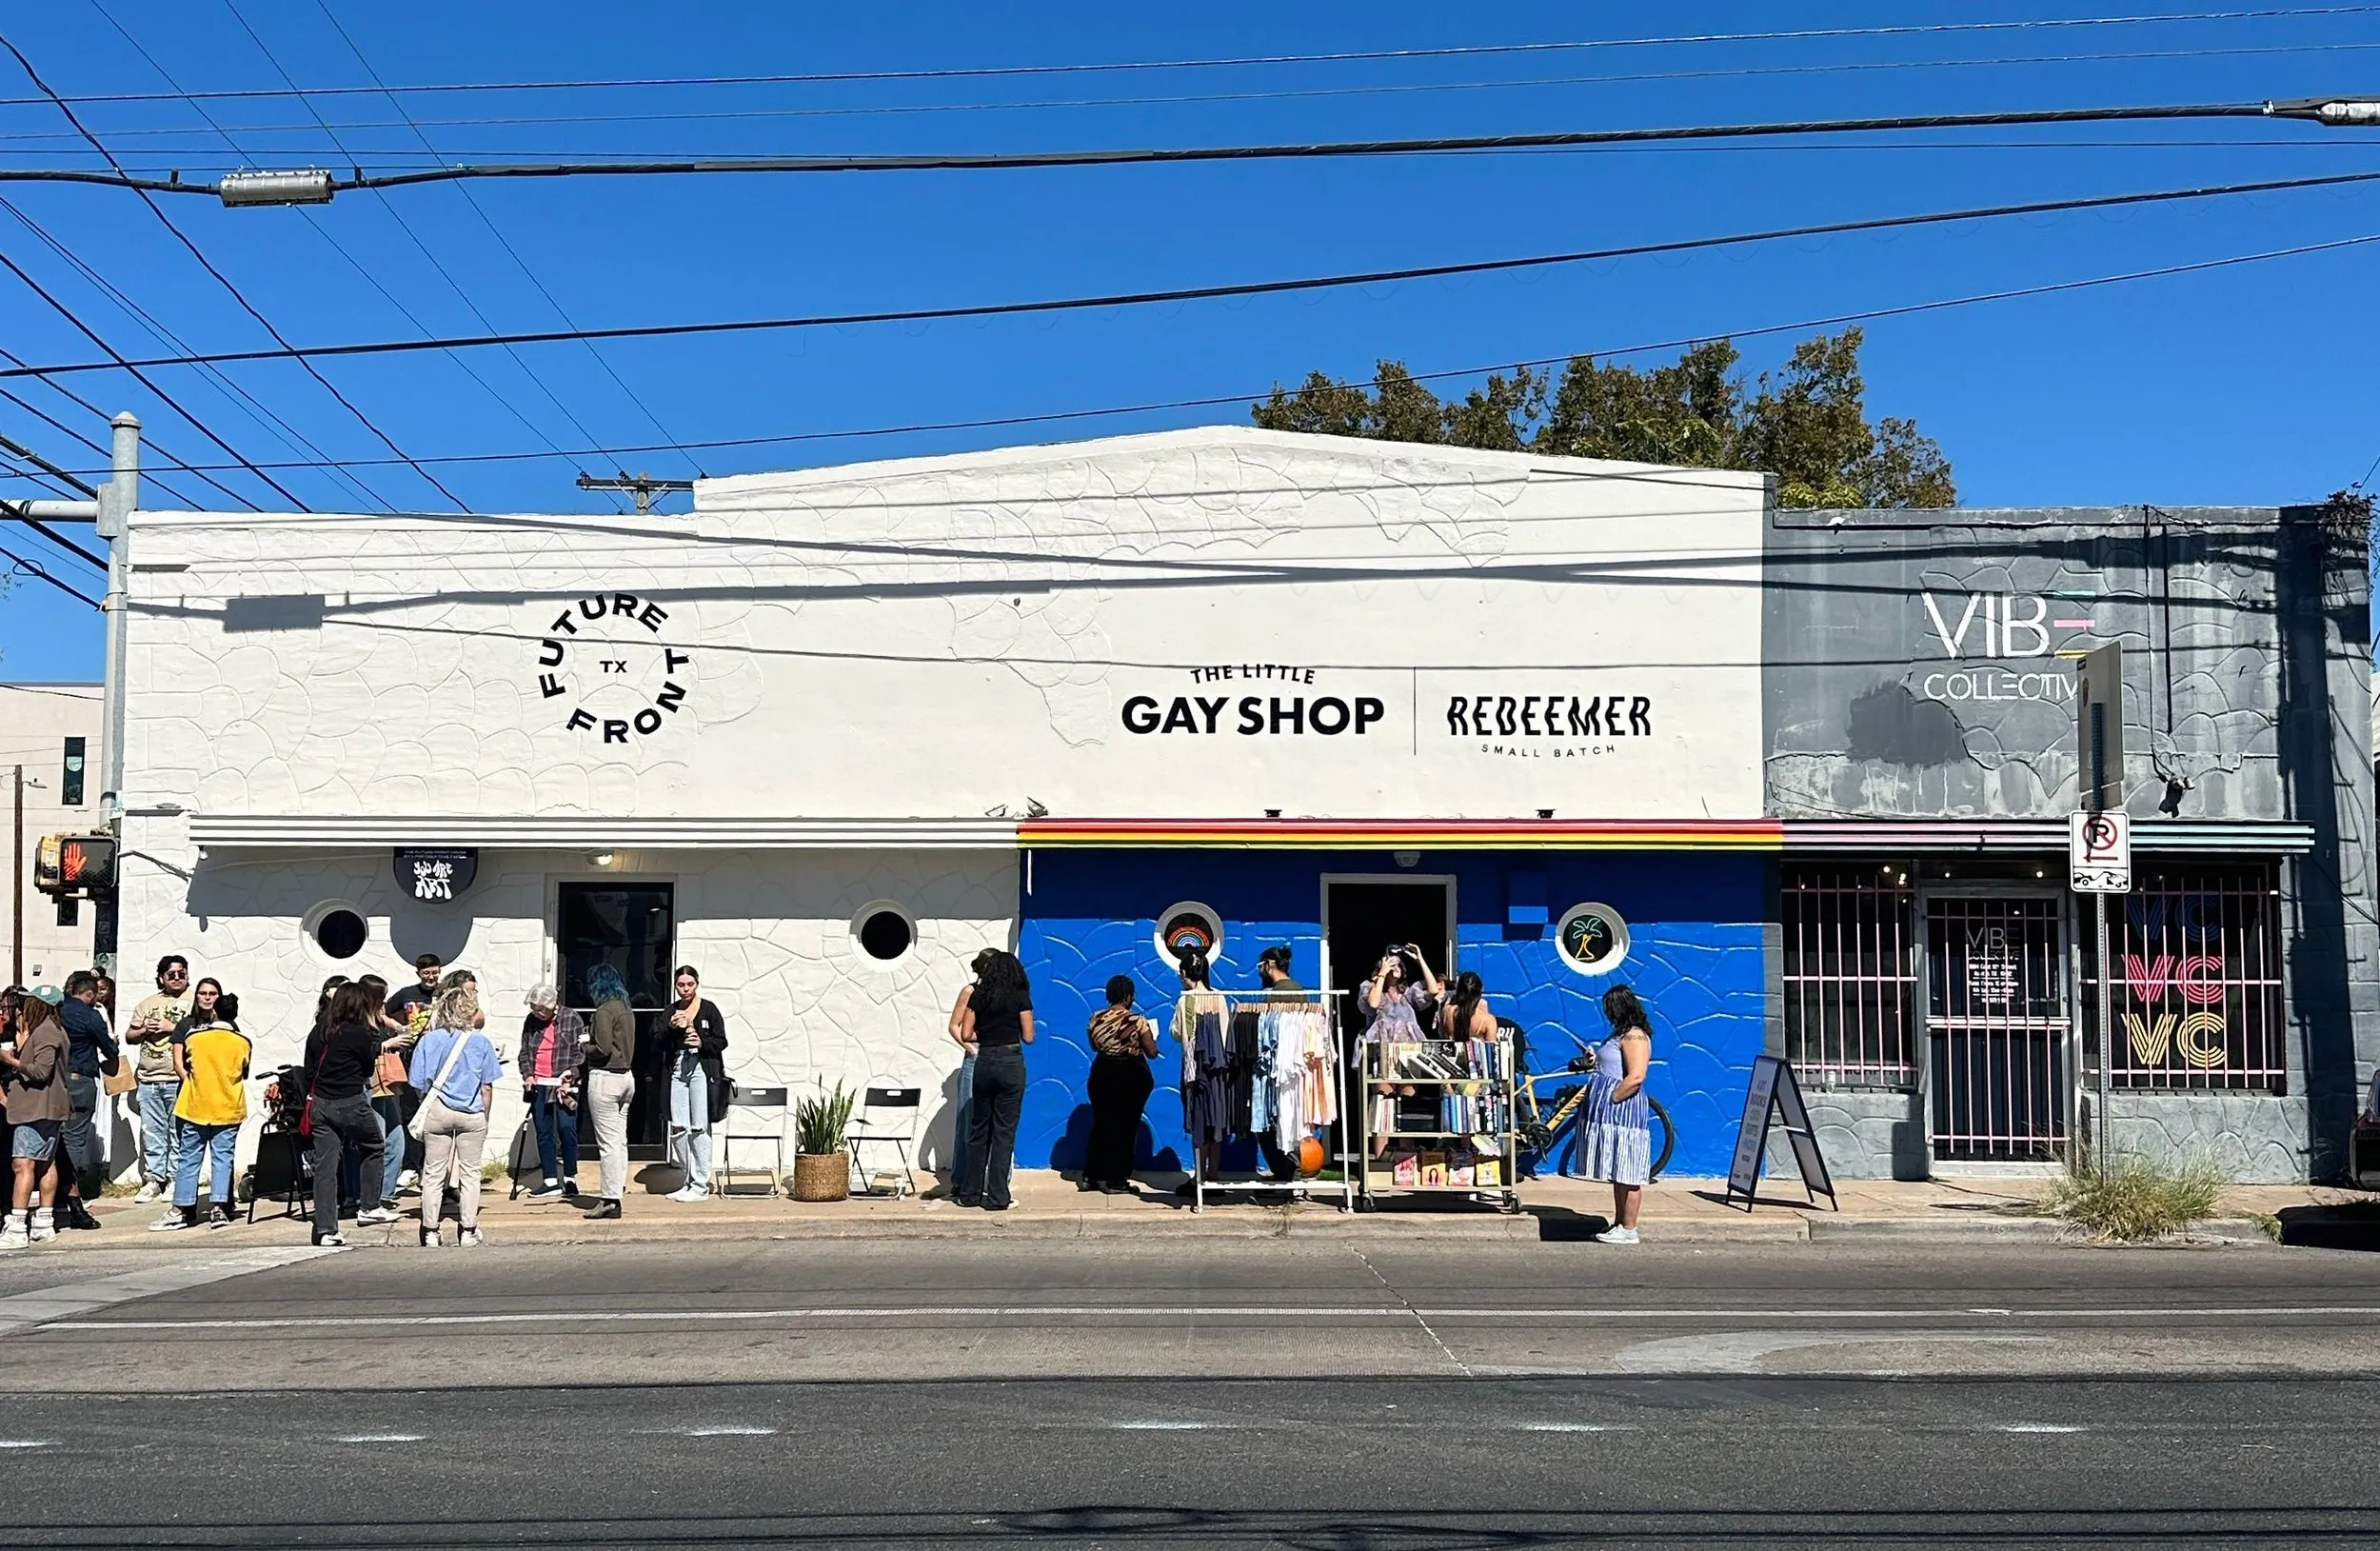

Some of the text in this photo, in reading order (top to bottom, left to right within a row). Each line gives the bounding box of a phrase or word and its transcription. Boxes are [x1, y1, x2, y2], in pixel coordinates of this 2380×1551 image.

[1921, 590, 2096, 659] VIBE
[538, 592, 669, 699] FUTURE
[599, 661, 628, 673] TX
[1190, 664, 1316, 685] THE LITTLE
[1923, 673, 2078, 701] COLLECTIV
[565, 647, 689, 744] FRONT
[1121, 696, 1384, 736] GAY SHOP
[1446, 696, 1652, 736] REDEEMER
[1480, 743, 1616, 759] SMALL BATCH
[413, 859, 453, 879] YOU ARE
[415, 875, 452, 900] ART
[2121, 954, 2223, 1004] VC
[2120, 1012, 2226, 1067] VC
